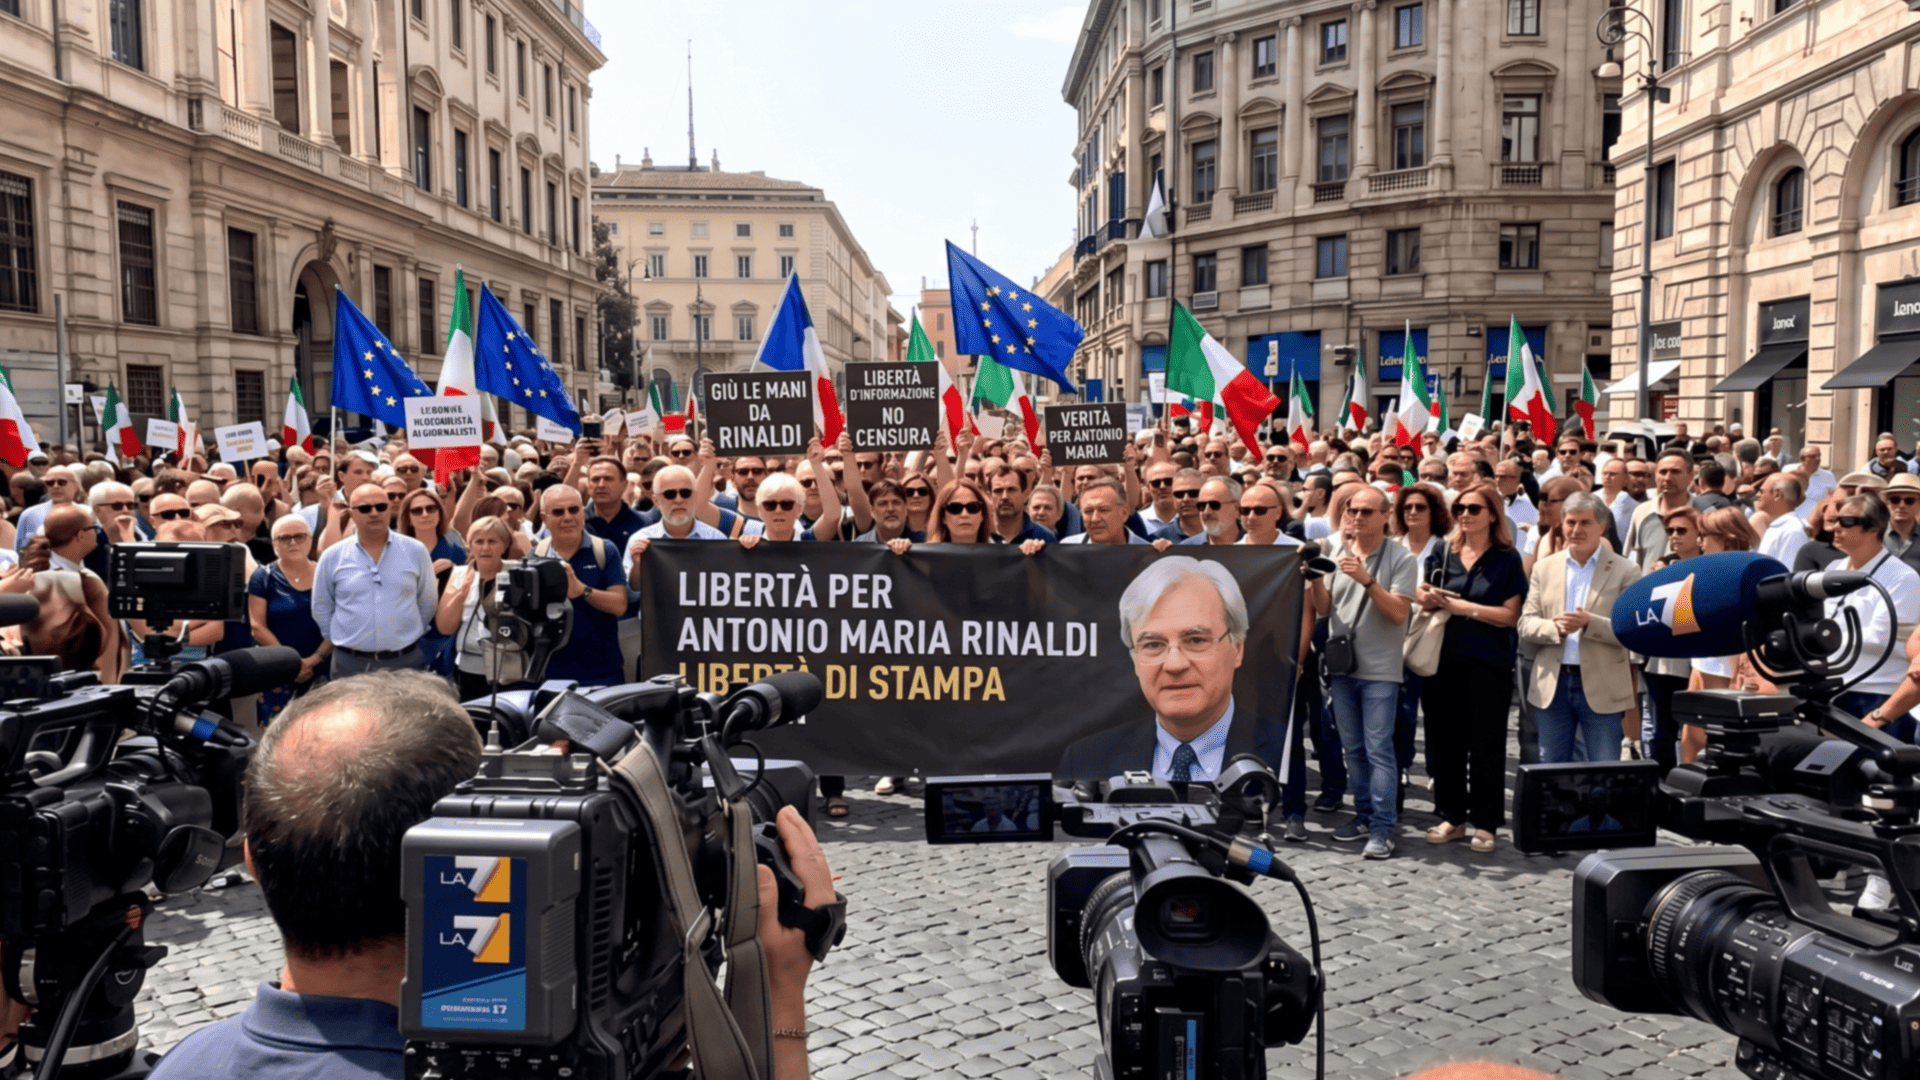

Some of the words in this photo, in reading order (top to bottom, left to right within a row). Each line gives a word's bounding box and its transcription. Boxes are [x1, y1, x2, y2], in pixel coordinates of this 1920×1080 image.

[864, 365, 921, 386] LIBERTÀ
[711, 379, 738, 401] GIÙ
[743, 382, 761, 400] LE
[765, 380, 807, 399] MANI
[850, 387, 935, 401] D'INFORMAZIONE
[749, 403, 771, 422] DA
[882, 407, 904, 425] NO
[1060, 406, 1111, 427] VERITÀ
[412, 429, 421, 438] AI
[423, 427, 477, 437] GIORNALISTI
[719, 424, 802, 449] RINALDI
[856, 427, 931, 447] CENSURA
[1049, 430, 1071, 443] PER
[1074, 427, 1123, 442] ANTONIO
[1065, 444, 1108, 460] MARIA
[679, 564, 818, 608] LIBERTÀ
[829, 573, 893, 609] PER
[677, 617, 829, 654] ANTONIO
[840, 619, 951, 655] MARIA
[962, 620, 1098, 657] RINALDI
[826, 664, 857, 699] DI
[868, 665, 1006, 701] STAMPA
